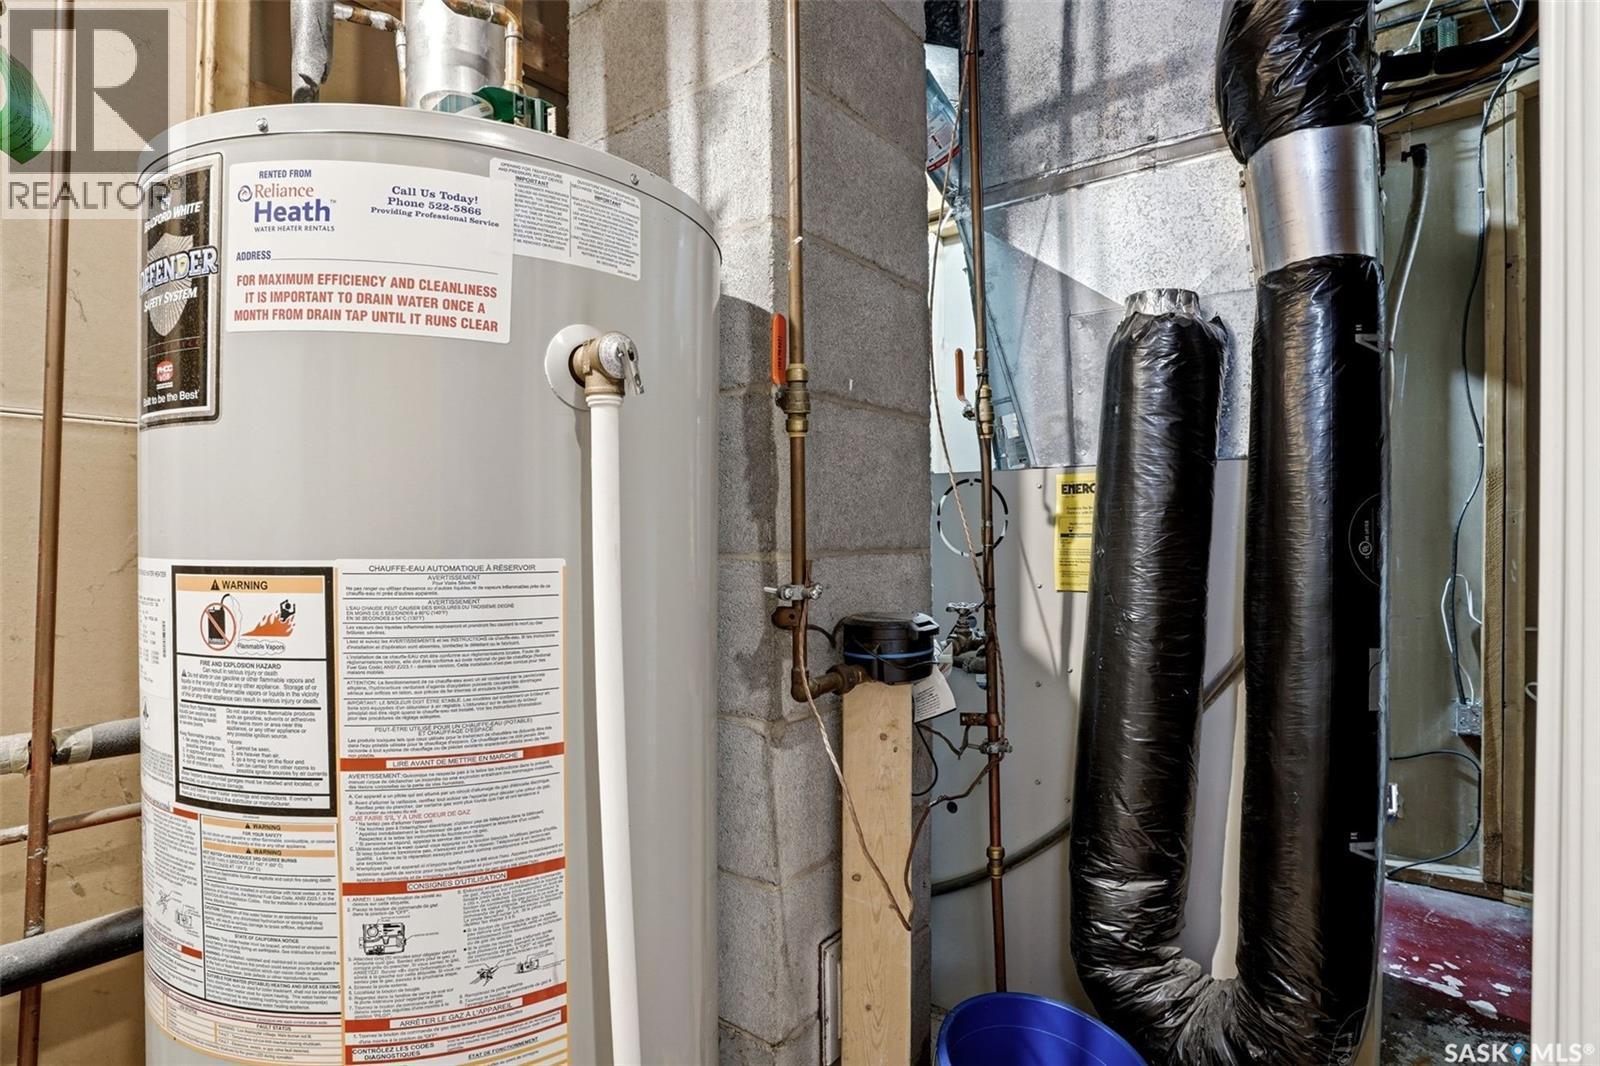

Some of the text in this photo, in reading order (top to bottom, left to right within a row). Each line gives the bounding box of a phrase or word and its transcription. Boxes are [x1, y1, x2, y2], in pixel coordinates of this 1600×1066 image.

[259, 169, 312, 179] RENTED FROM
[515, 175, 549, 188] IMPORTANT
[254, 183, 314, 199] Reliance
[391, 185, 478, 205] Call Us Today!
[173, 200, 204, 219] WHITE
[387, 196, 482, 216] Phone 522-5866
[370, 206, 500, 228] Providing Professional Service
[254, 225, 276, 233] WATER
[236, 250, 272, 261] ADDRESS
[236, 273, 498, 298] FOR MAXIMUM EFFICIENCY AND CLEANLINESS
[164, 287, 198, 303] SYSTEM
[245, 291, 486, 314] IT IS IMPORTANT TO DRAIN WATER ONCE A
[234, 308, 499, 333] MONTH FROM DRAIN TAP UNTIL IT RUNS CLEAR
[167, 393, 178, 402] the
[427, 564, 485, 572] AUTOMATIQUE
[222, 580, 268, 590] WARNING
[237, 641, 285, 652] Flammable Vapors
[223, 661, 255, 669] EXPLOSION
[448, 757, 477, 765] METTRE
[489, 752, 518, 761] MARCHE
[252, 823, 281, 831] WARNING
[253, 848, 282, 856] WARNING
[408, 879, 453, 890] CONSIGNES
[437, 1015, 447, 1023] LE
[448, 1013, 463, 1021] GAZ
[395, 1044, 409, 1052] LES
[410, 1042, 435, 1051] CODES
